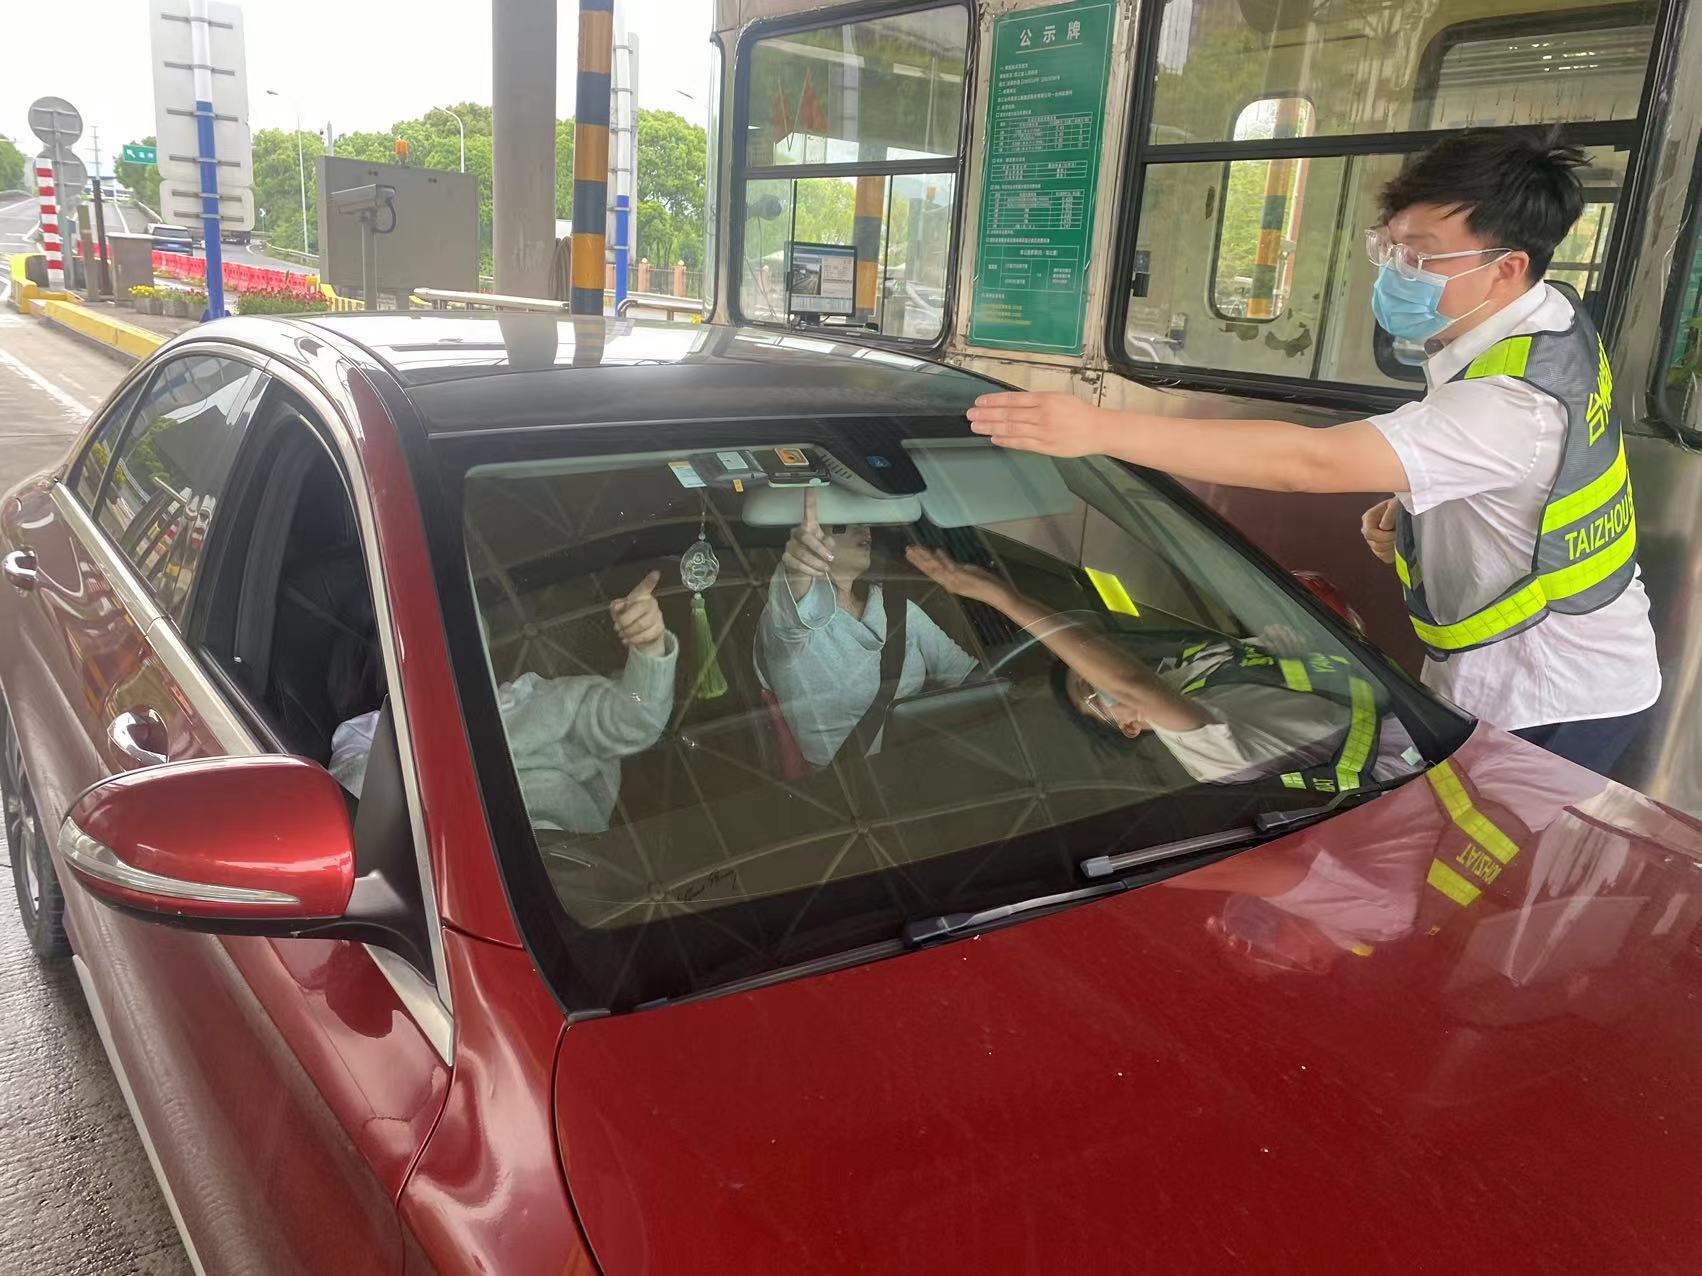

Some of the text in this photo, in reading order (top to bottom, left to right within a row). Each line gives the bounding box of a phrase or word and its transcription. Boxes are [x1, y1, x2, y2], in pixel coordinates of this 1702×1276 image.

[1020, 20, 1081, 47] 公示牌
[1565, 494, 1629, 561] TAIZHOU
